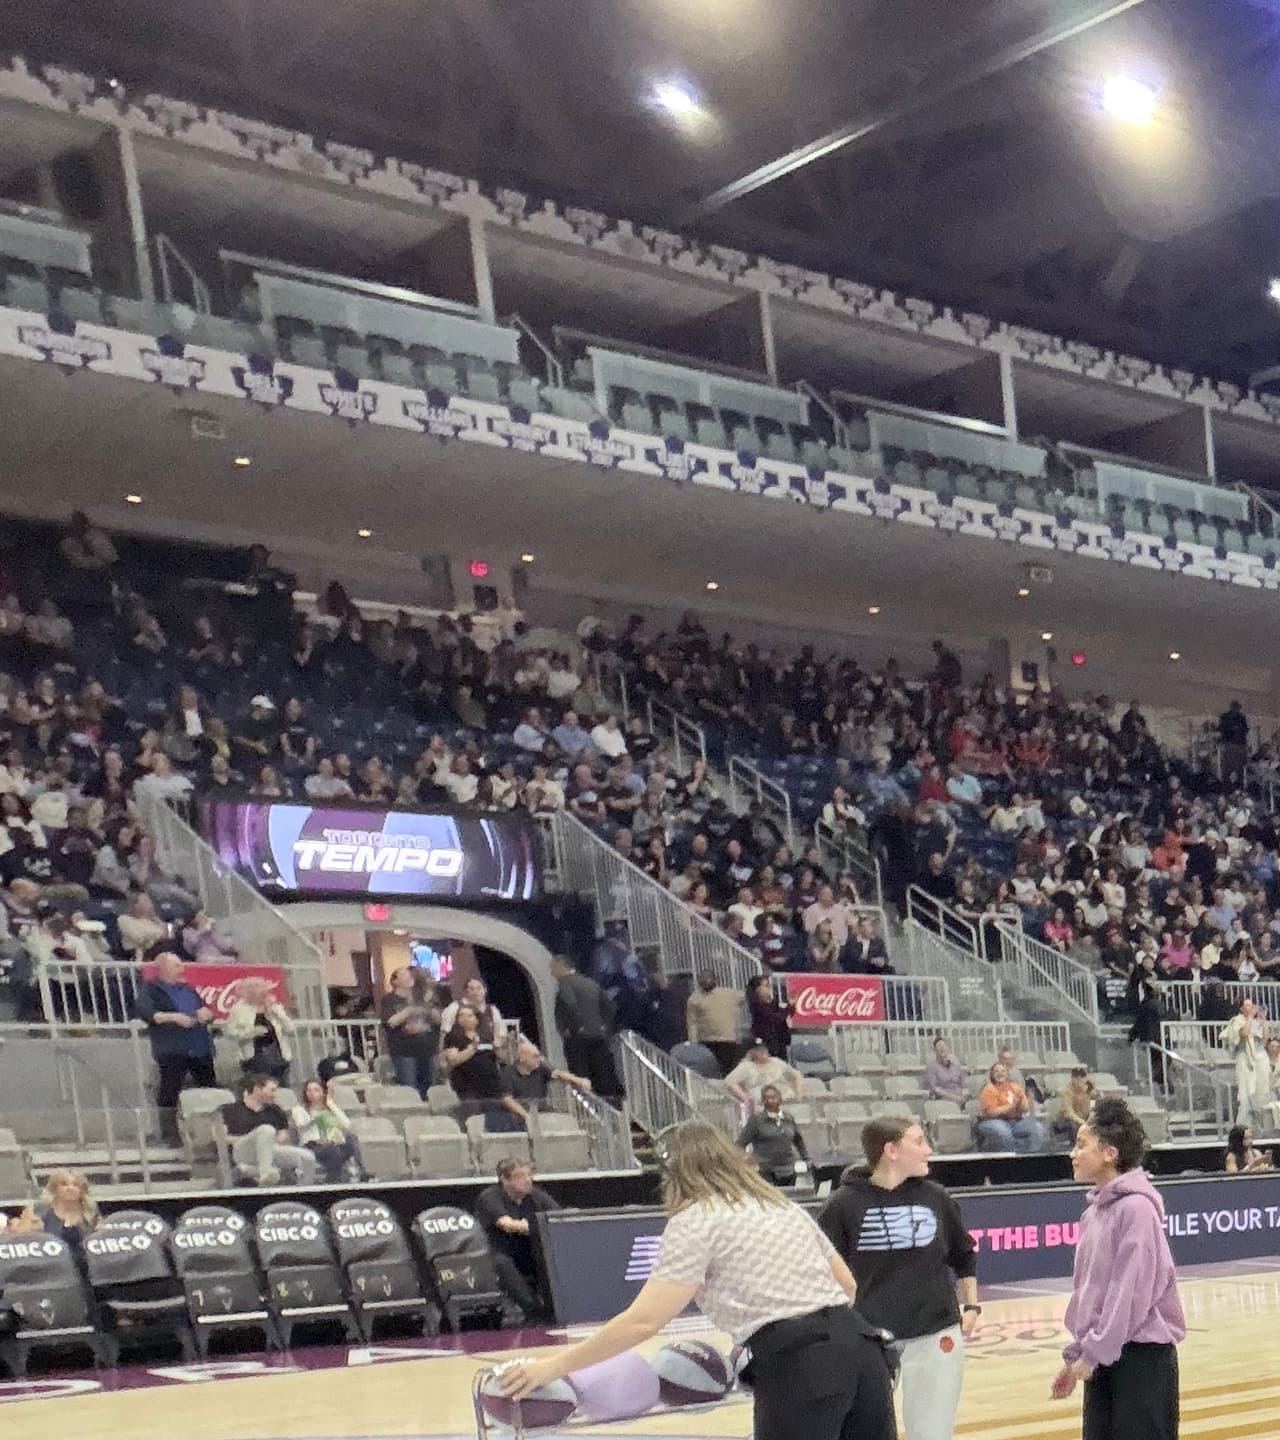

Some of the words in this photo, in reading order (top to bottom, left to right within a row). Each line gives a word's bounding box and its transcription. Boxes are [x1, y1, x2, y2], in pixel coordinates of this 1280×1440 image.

[293, 839, 465, 877] TEMPO
[795, 987, 880, 1018] Coca-Cola
[259, 1227, 300, 1242] CIBC
[337, 1223, 375, 1239] CIBC
[423, 1218, 459, 1233] CIBC
[987, 1226, 1039, 1252] THE
[1045, 1222, 1080, 1247] BU
[1202, 1207, 1262, 1234] YOUR
[86, 1234, 134, 1255] CIBC
[174, 1230, 218, 1248] CIBC
